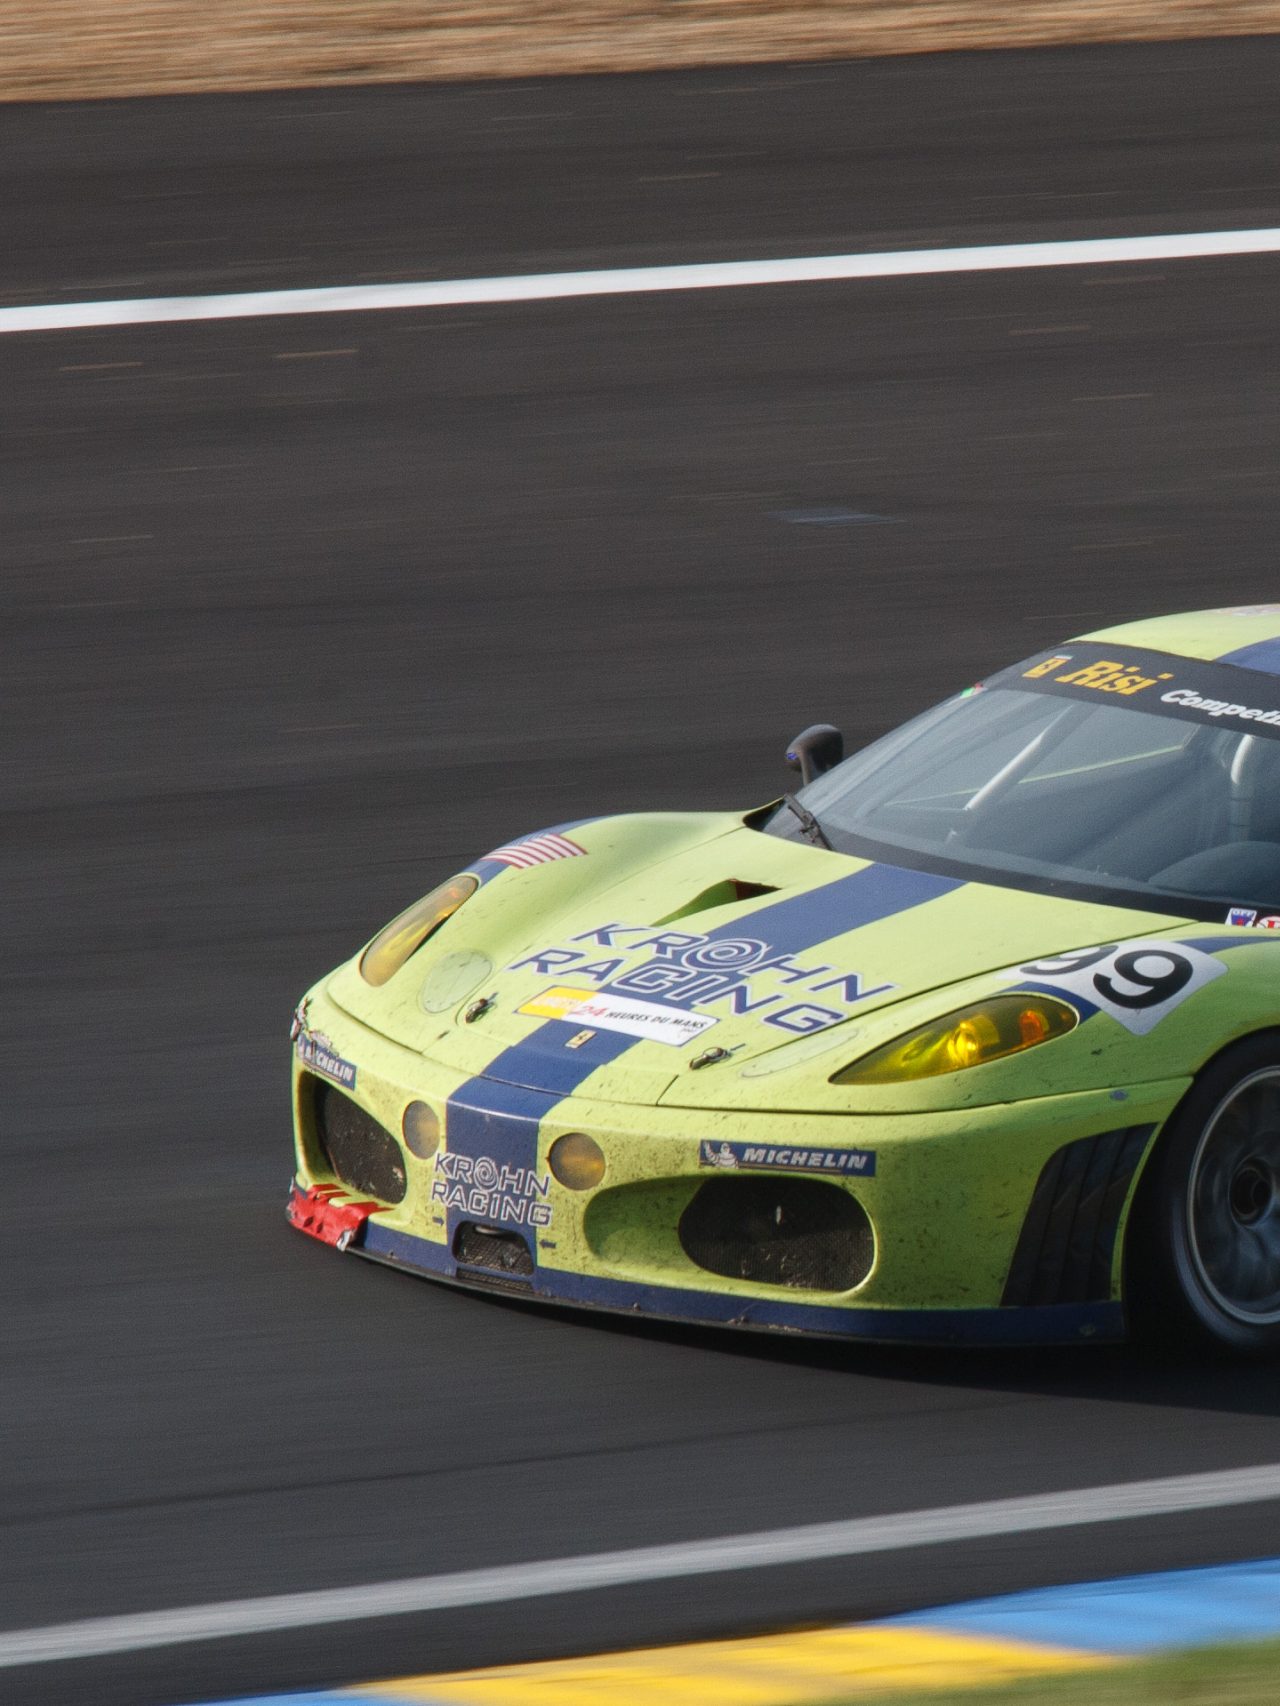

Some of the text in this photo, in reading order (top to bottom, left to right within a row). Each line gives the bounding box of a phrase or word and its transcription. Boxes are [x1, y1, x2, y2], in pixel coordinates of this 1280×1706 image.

[1055, 660, 1174, 695] Risi
[571, 921, 899, 1003] KROHN
[505, 948, 847, 1033] RACING
[567, 1004, 707, 1029] 24 HEURES DU MANS
[434, 1151, 550, 1198] KROHN
[743, 1148, 867, 1169] MICHELIN
[431, 1180, 552, 1227] RACING
